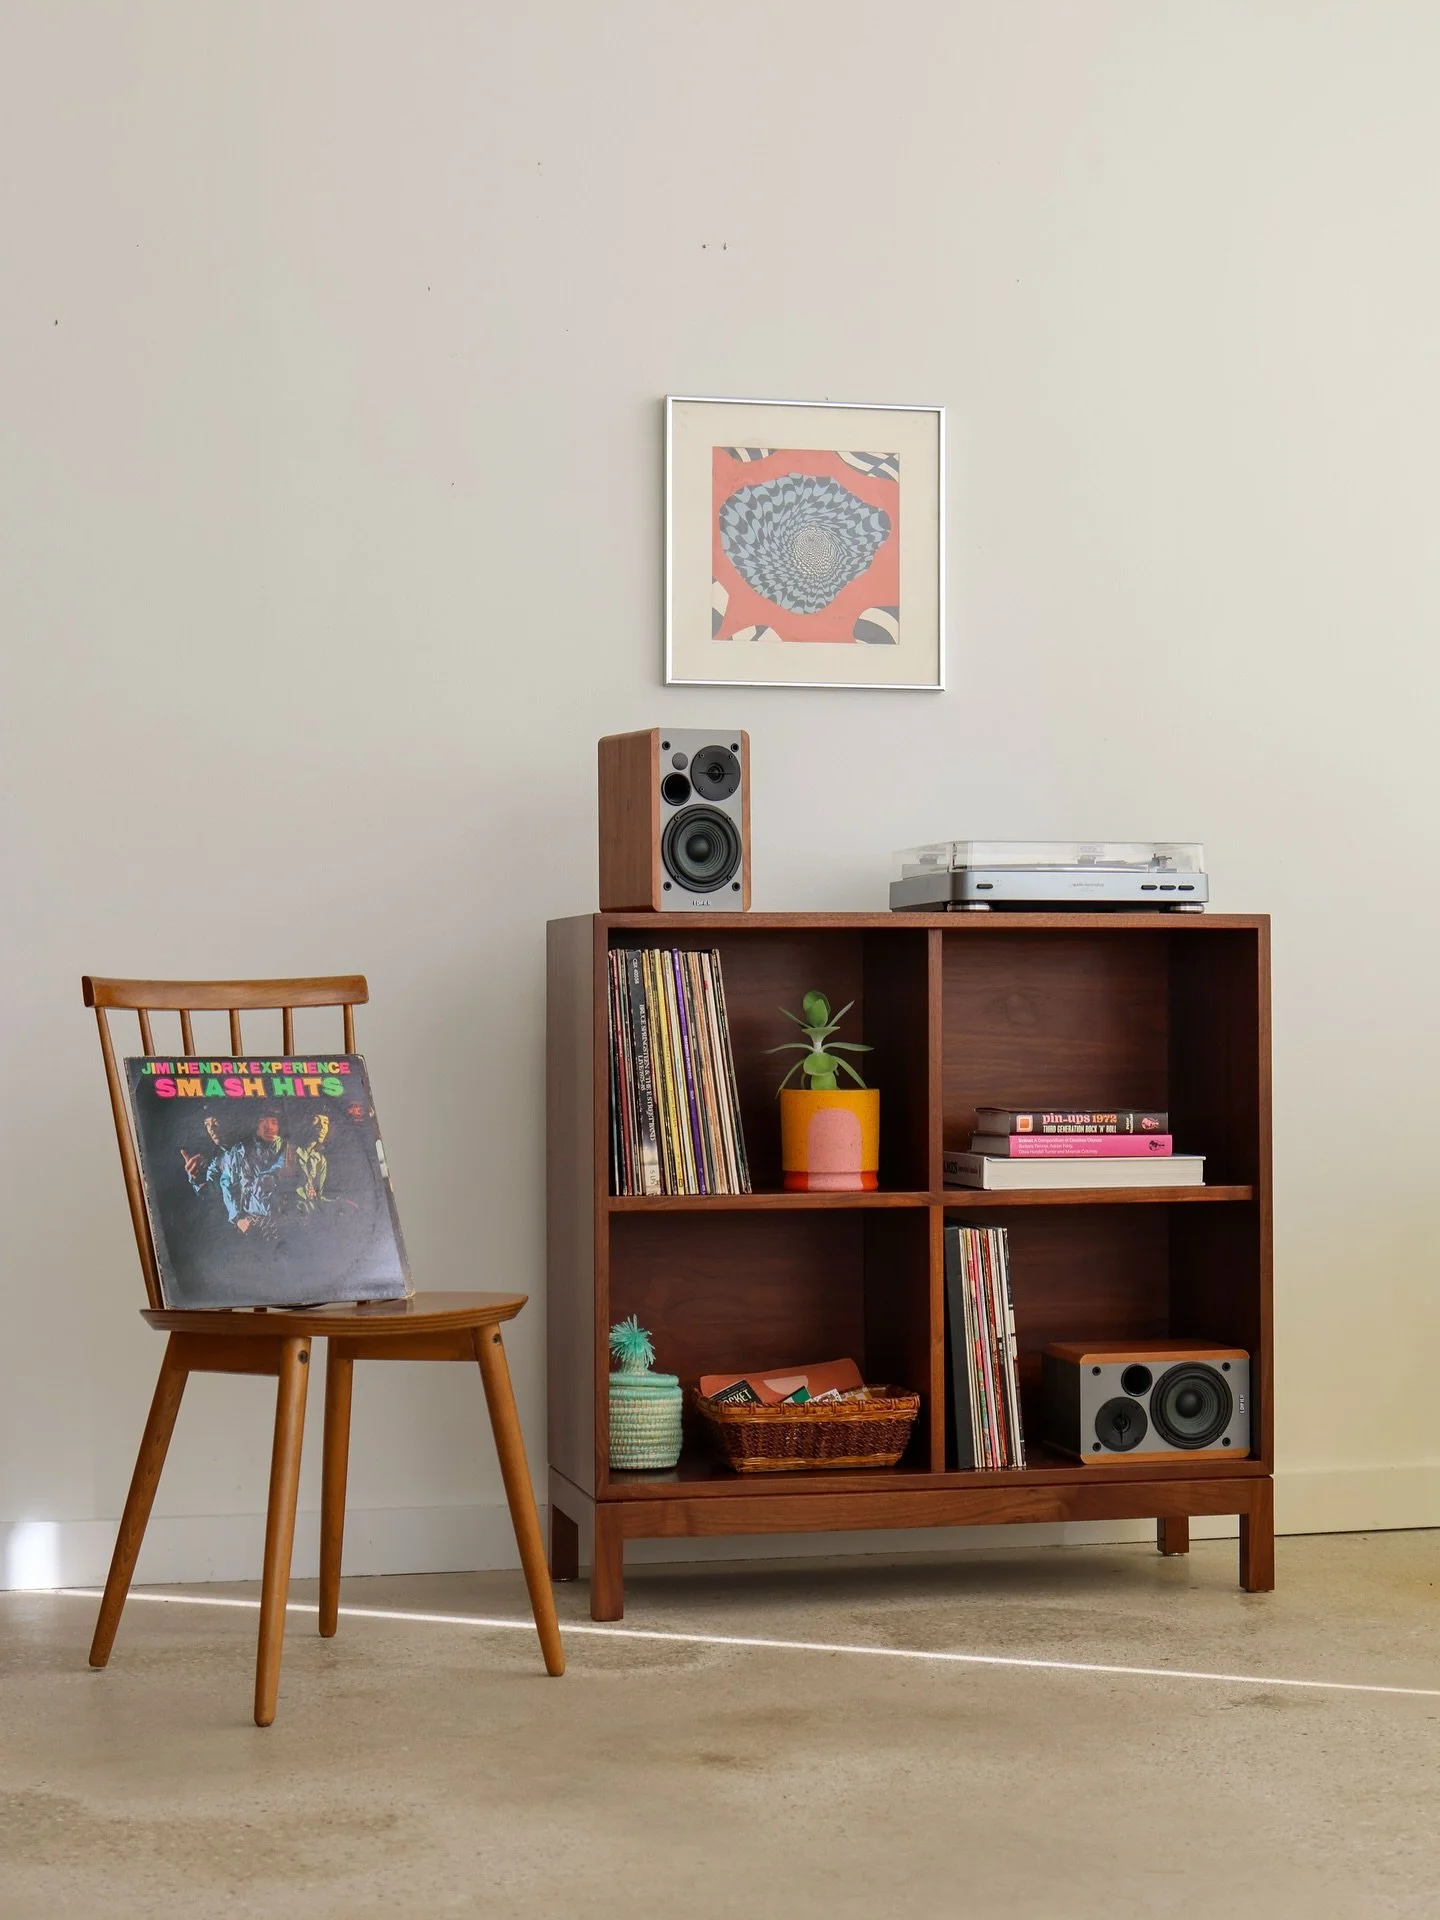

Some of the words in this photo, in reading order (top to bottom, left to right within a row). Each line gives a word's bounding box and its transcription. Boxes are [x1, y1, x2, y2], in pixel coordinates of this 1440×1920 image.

[141, 1062, 175, 1074] JIMI
[176, 1062, 248, 1074] HENDRIX
[250, 1062, 351, 1074] EXPERIENCE
[155, 1078, 265, 1098] SMASH
[272, 1077, 344, 1097] HITS
[1042, 1112, 1091, 1125] pin-ups
[1092, 1113, 1117, 1123] 1972
[1043, 1125, 1057, 1134] THIRD
[1057, 1125, 1085, 1134] GENERATION
[1085, 1125, 1098, 1134] ROCK
[1106, 1125, 1117, 1133] ROLL
